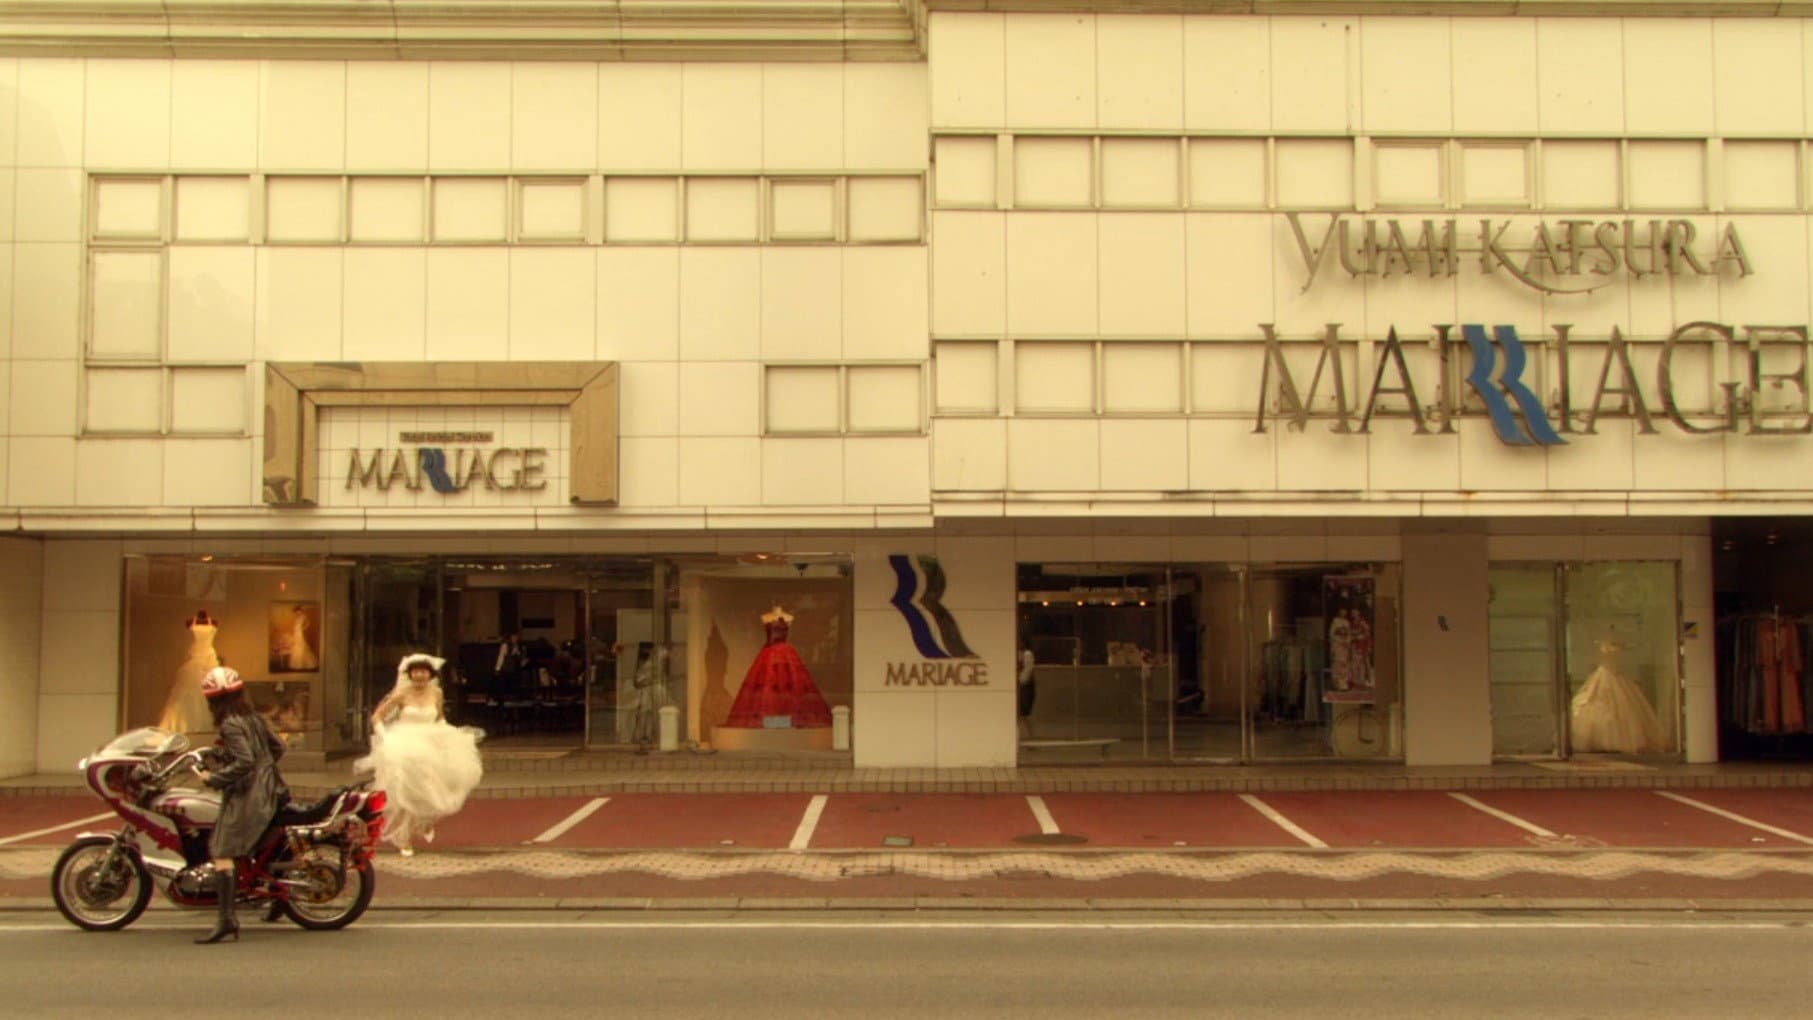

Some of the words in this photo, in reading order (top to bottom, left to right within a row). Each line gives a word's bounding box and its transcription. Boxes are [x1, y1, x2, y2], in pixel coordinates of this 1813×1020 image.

[1286, 211, 1457, 294] YUMI
[1481, 219, 1755, 294] KATSURA
[885, 662, 988, 686] MARIAGE
